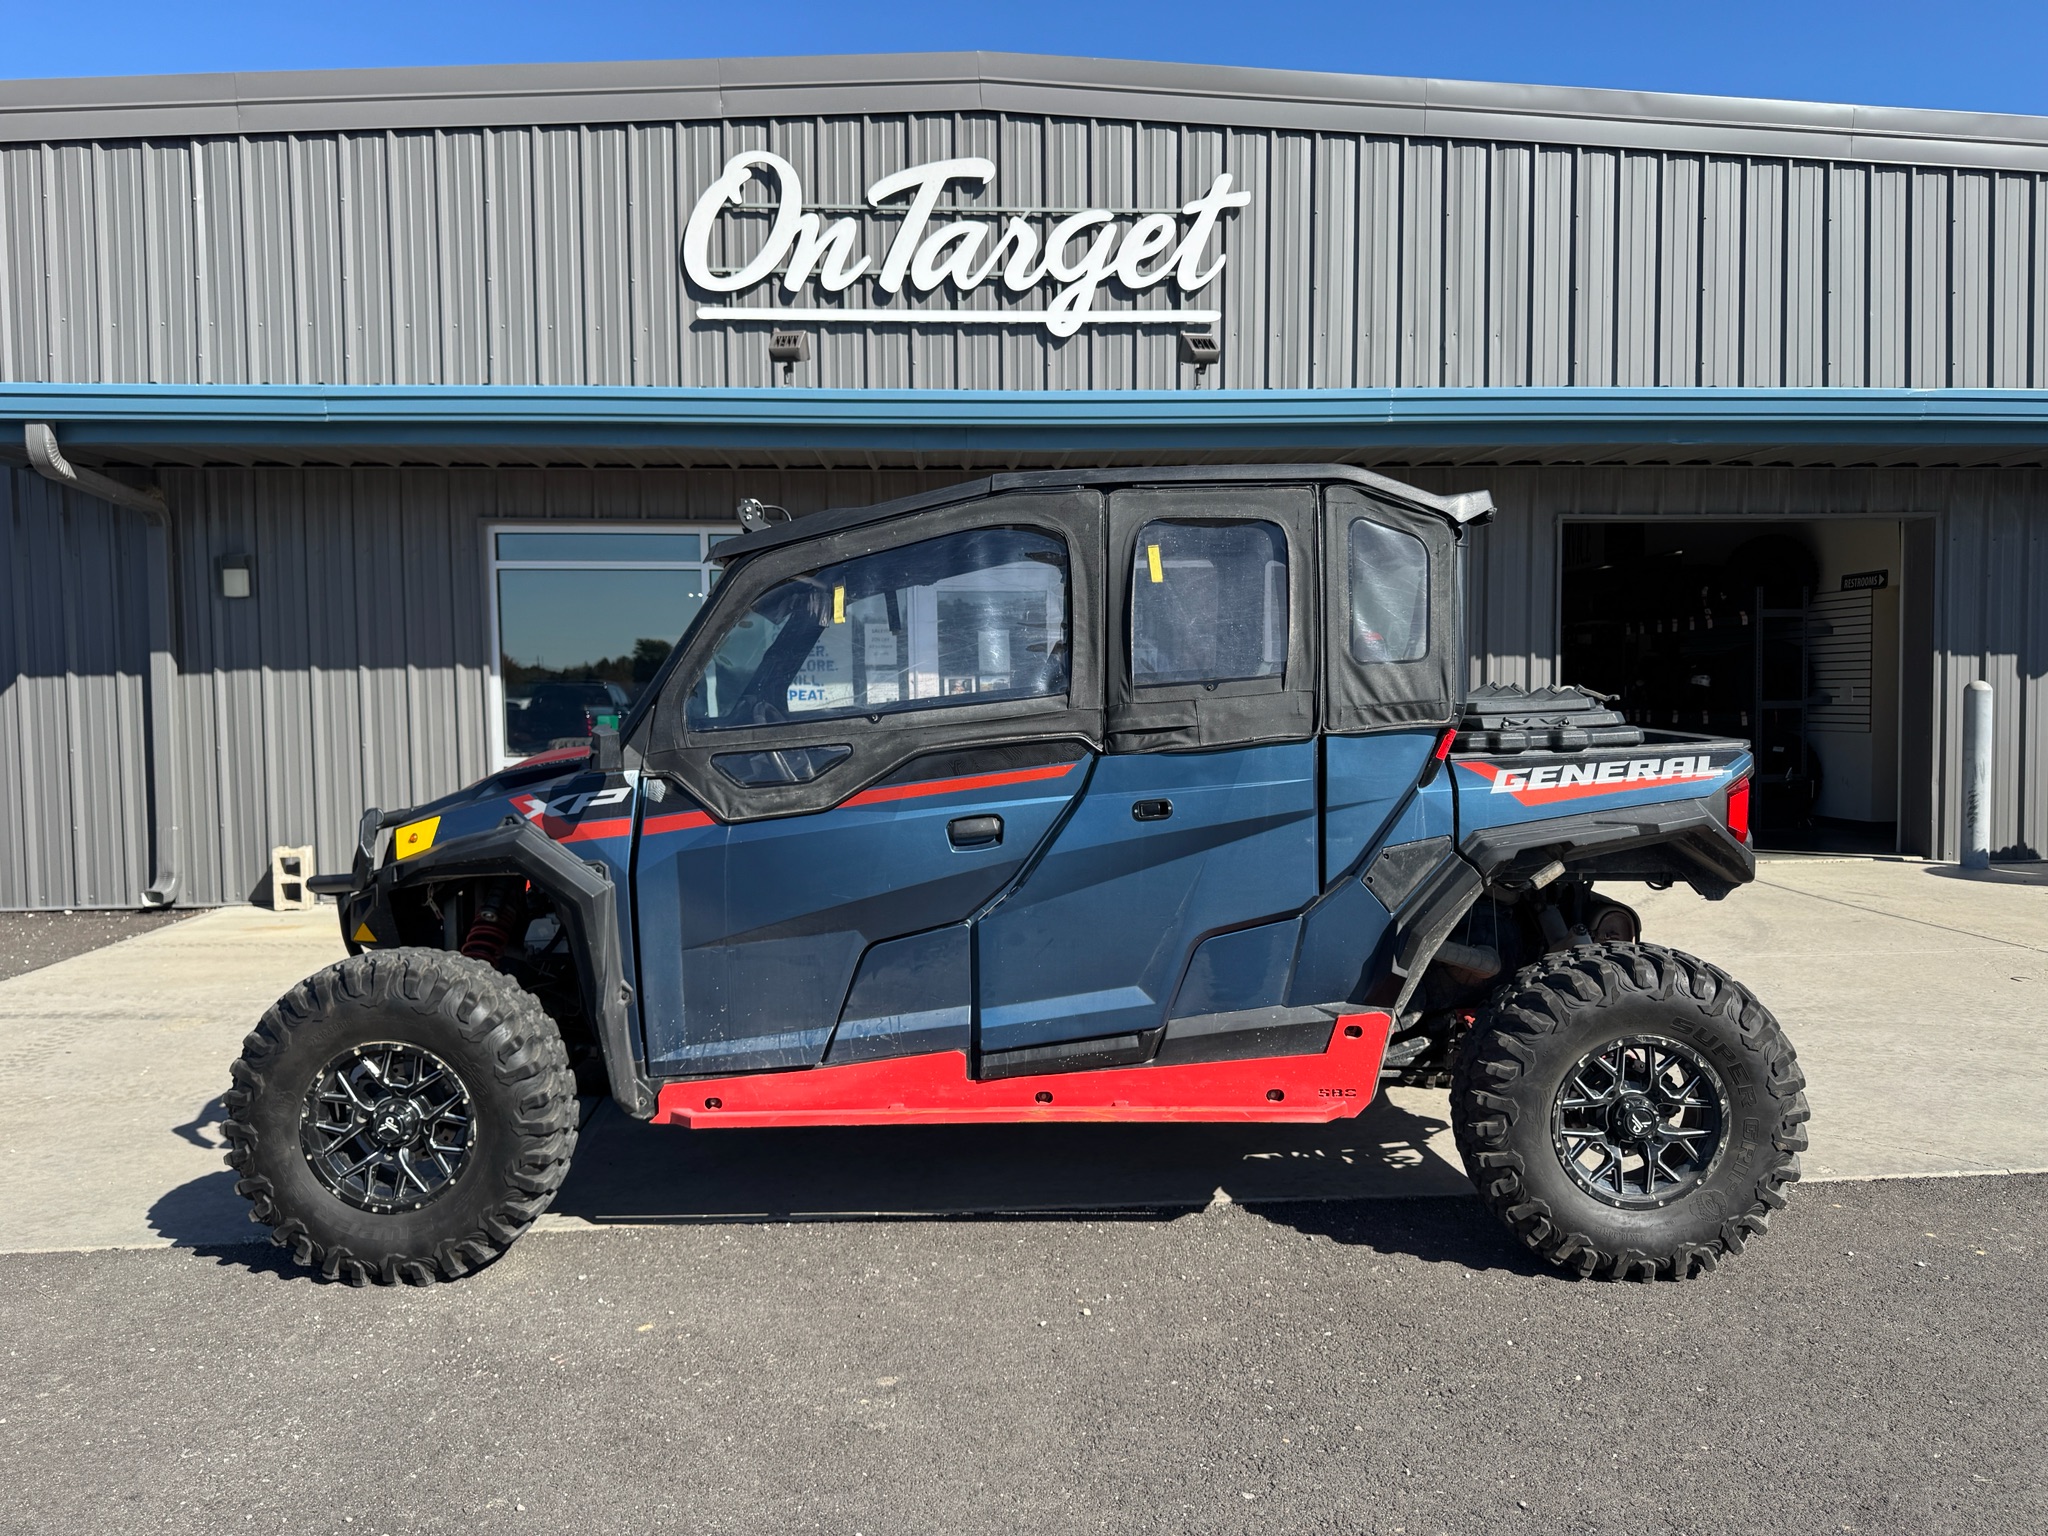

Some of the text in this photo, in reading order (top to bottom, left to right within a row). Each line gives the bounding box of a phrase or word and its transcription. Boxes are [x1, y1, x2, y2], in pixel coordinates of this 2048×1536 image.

[1844, 575, 1878, 589] RESTROOMS
[789, 689, 828, 701] PEAT.
[1490, 756, 1724, 794] GENERAL
[1670, 1016, 1760, 1196] SUPER GRIP
